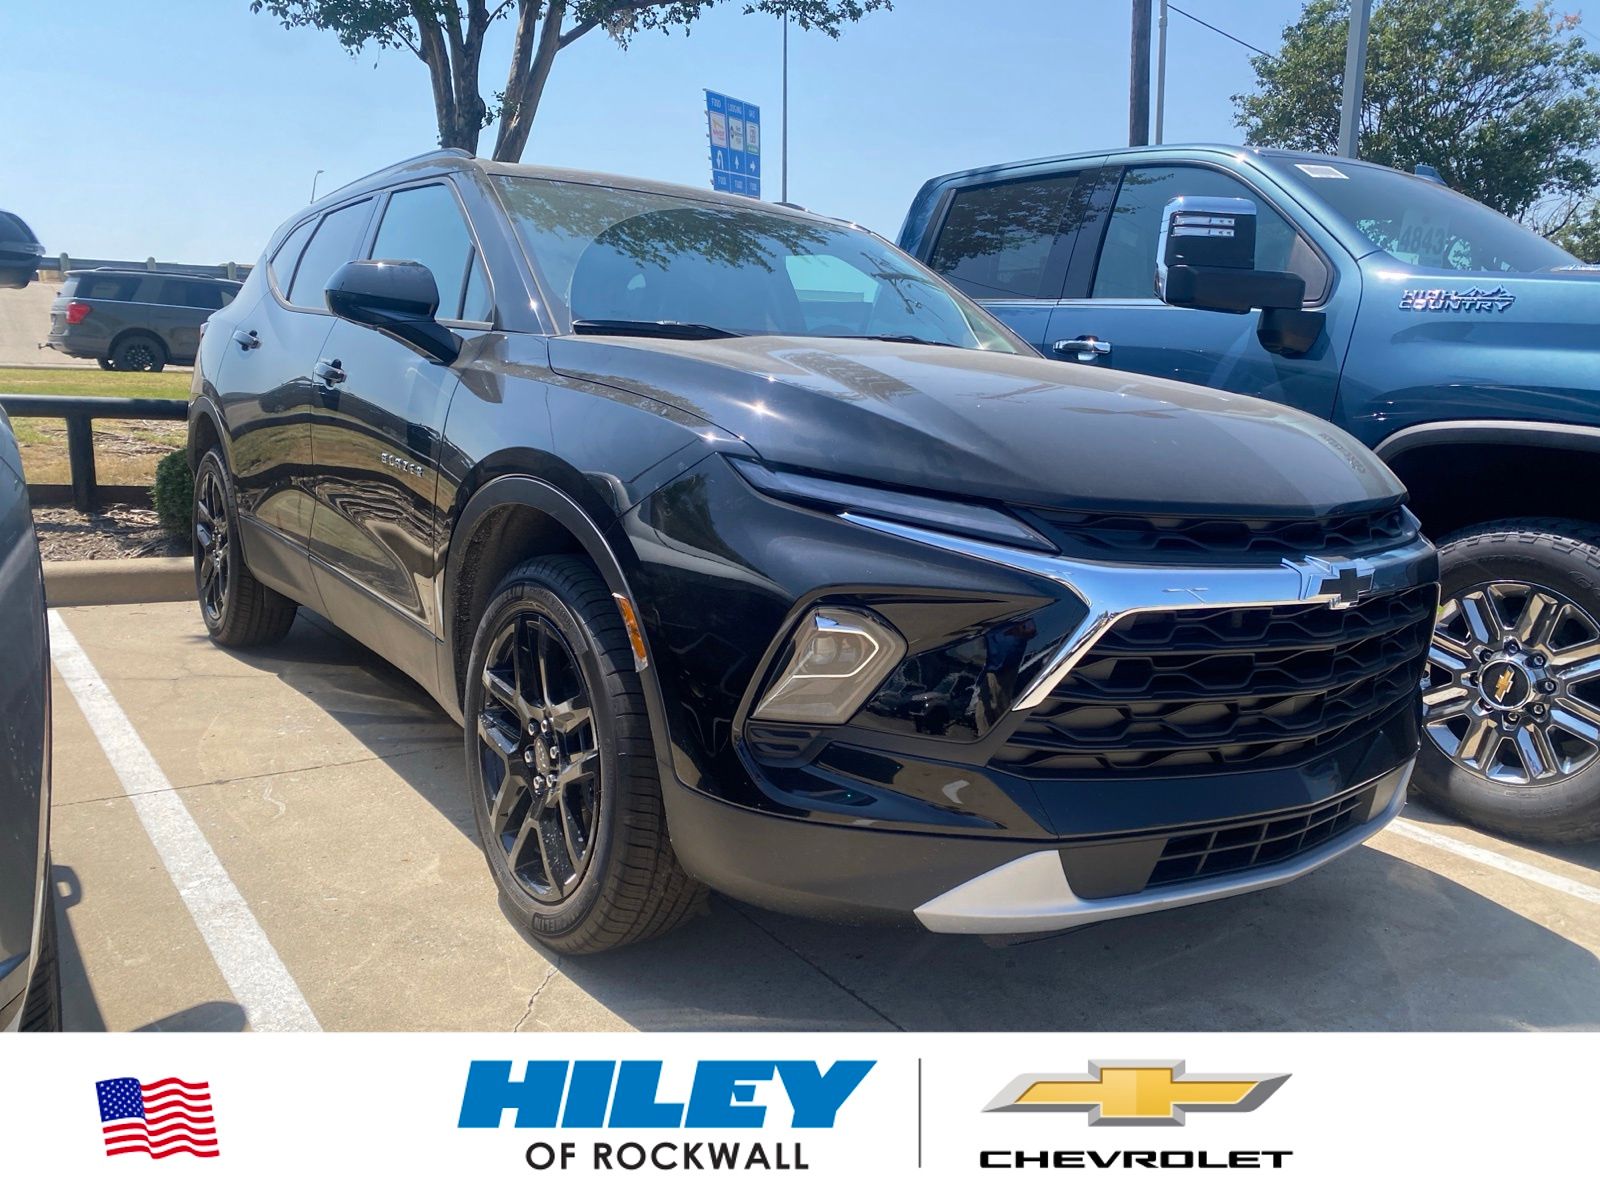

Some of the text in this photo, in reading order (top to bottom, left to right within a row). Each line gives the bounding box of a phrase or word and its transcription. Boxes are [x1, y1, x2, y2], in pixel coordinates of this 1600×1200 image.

[1401, 225, 1444, 254] 4843
[1402, 289, 1457, 300] HIGH
[1398, 300, 1513, 311] COUNTRY
[381, 452, 424, 478] BLAZER
